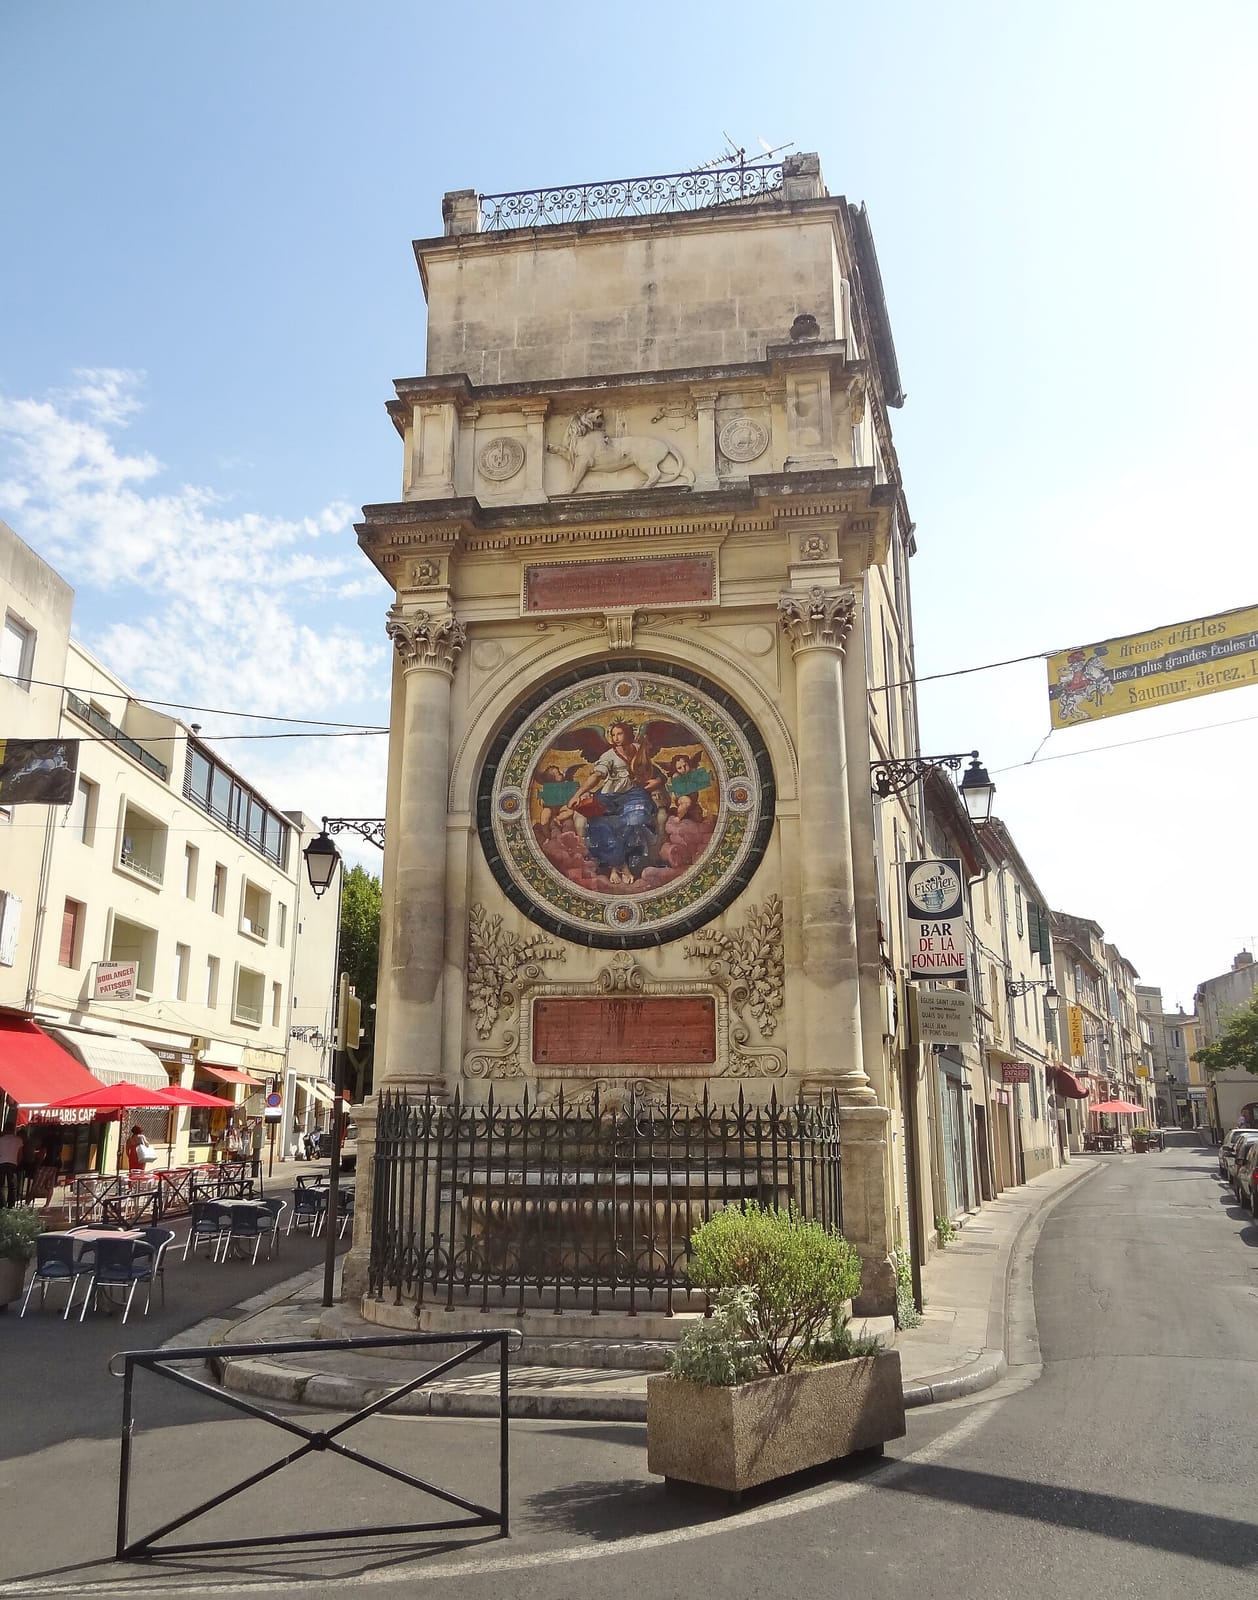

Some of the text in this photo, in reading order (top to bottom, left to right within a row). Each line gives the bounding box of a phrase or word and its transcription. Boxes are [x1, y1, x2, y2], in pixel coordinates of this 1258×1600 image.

[1120, 620, 1226, 657] Arènes d'Arles
[1112, 669, 1127, 681] les
[1130, 666, 1138, 677] 4
[1141, 661, 1162, 676] plus
[1165, 649, 1208, 670] grandes
[1211, 641, 1246, 656] Écoles
[1128, 679, 1191, 704] Saumur,
[1196, 667, 1245, 688] Jerez,
[914, 876, 953, 897] Fischer
[920, 923, 952, 937] BAR
[919, 937, 955, 952] DE LA
[911, 953, 965, 969] FONTAINE
[97, 967, 135, 984] BOULANGER
[99, 979, 132, 993] PATISSIER
[1071, 1007, 1081, 1056] PIZZERIA
[28, 1109, 39, 1122] LE
[40, 1108, 77, 1122] TAMARIS
